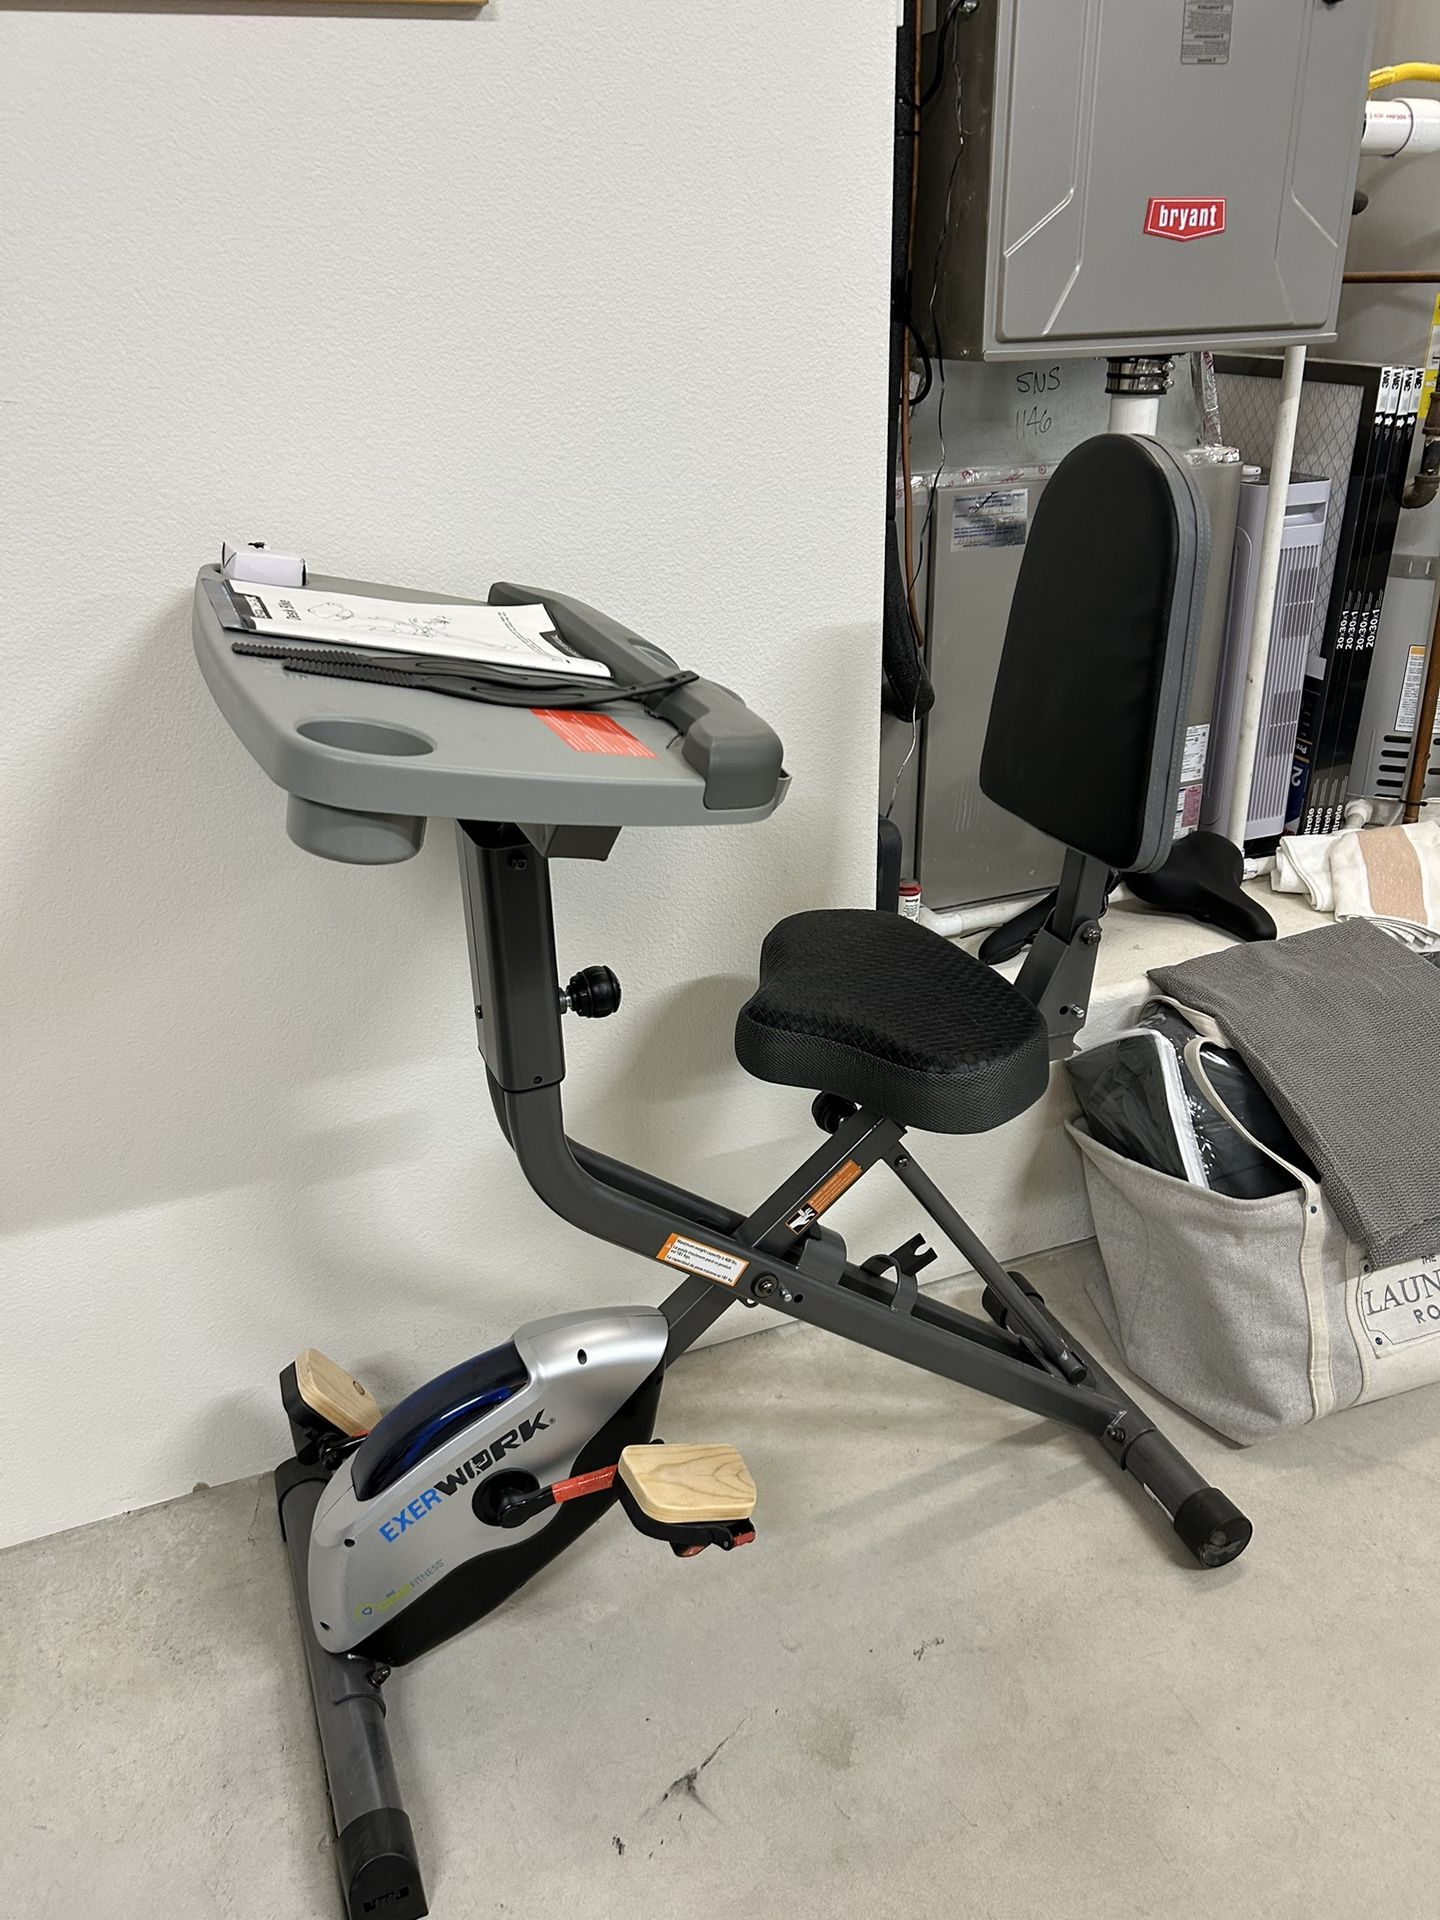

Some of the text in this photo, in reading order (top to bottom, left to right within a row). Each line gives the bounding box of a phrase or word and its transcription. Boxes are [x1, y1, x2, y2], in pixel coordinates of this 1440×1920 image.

[1159, 204, 1217, 231] bryant
[1016, 366, 1060, 394] SNS
[1382, 370, 1391, 389] 3M
[1391, 371, 1402, 390] 3M
[1403, 373, 1413, 392] 3M
[1414, 371, 1424, 389] 3M
[1015, 406, 1052, 440] 1146
[1336, 610, 1349, 650] 20x30x1
[1345, 611, 1358, 650] 20x30x1
[1355, 612, 1369, 651] 20x30x1
[1366, 609, 1380, 648] 20x30x1
[1421, 1253, 1437, 1265] THE
[1364, 1268, 1440, 1316] LAUN
[379, 1408, 549, 1543] EXERWORK
